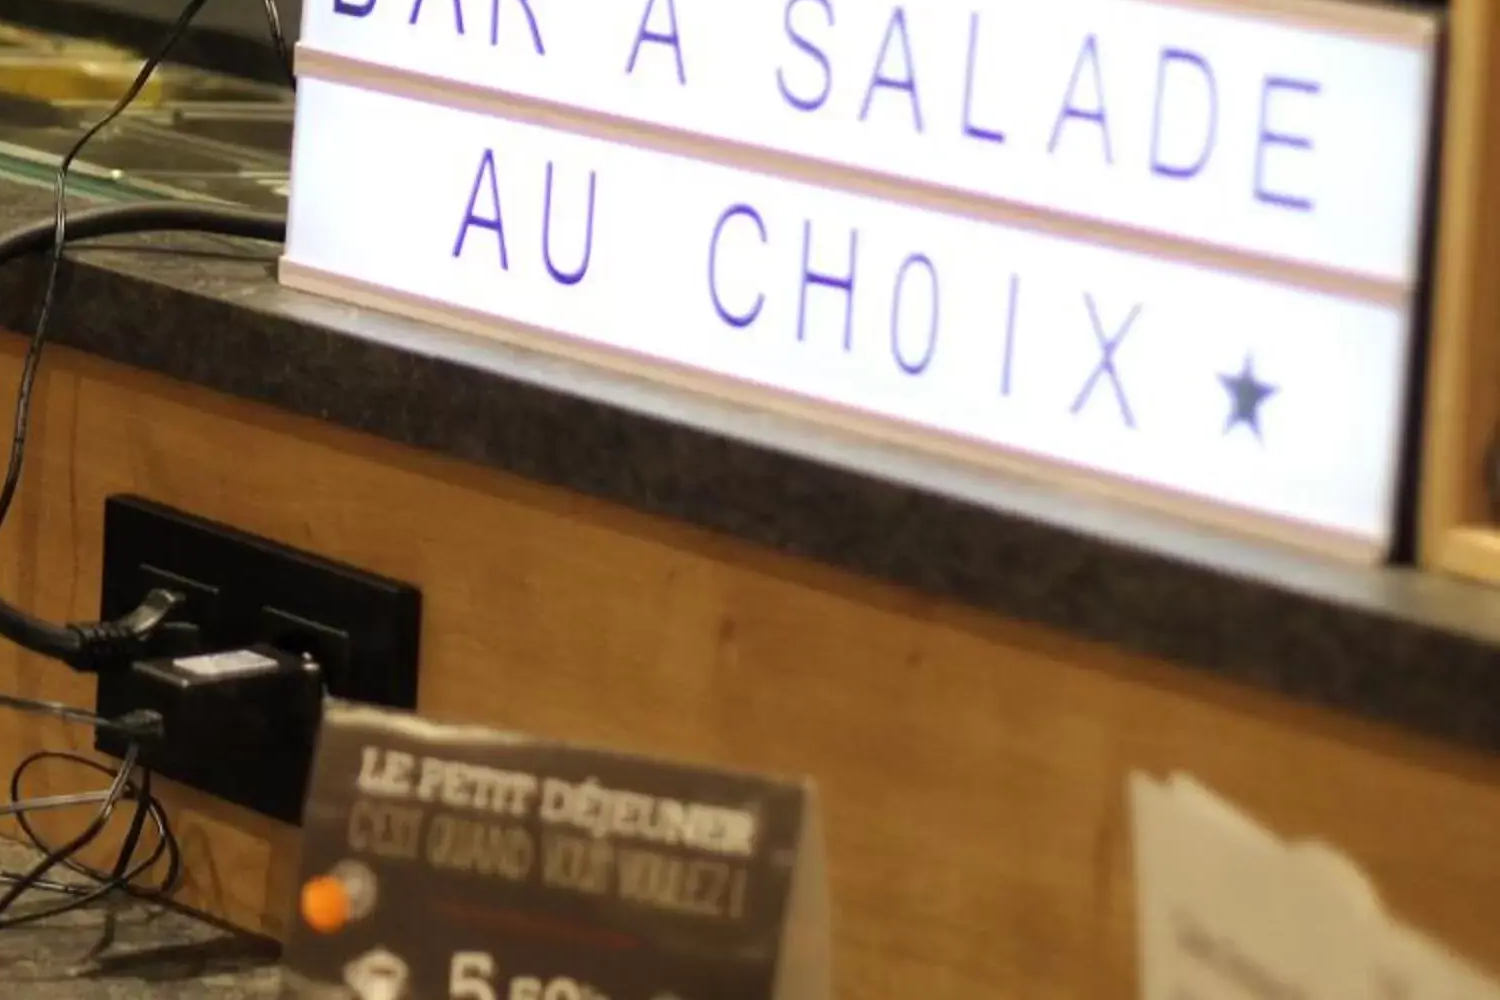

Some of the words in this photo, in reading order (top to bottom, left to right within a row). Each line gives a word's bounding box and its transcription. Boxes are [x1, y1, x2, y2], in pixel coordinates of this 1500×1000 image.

[451, 146, 598, 287] AU
[707, 201, 1144, 431] CHOIX
[359, 747, 413, 794] LE
[418, 756, 536, 815] PETIT
[541, 776, 755, 855] DÉJEUNER
[428, 816, 534, 878] QUAND
